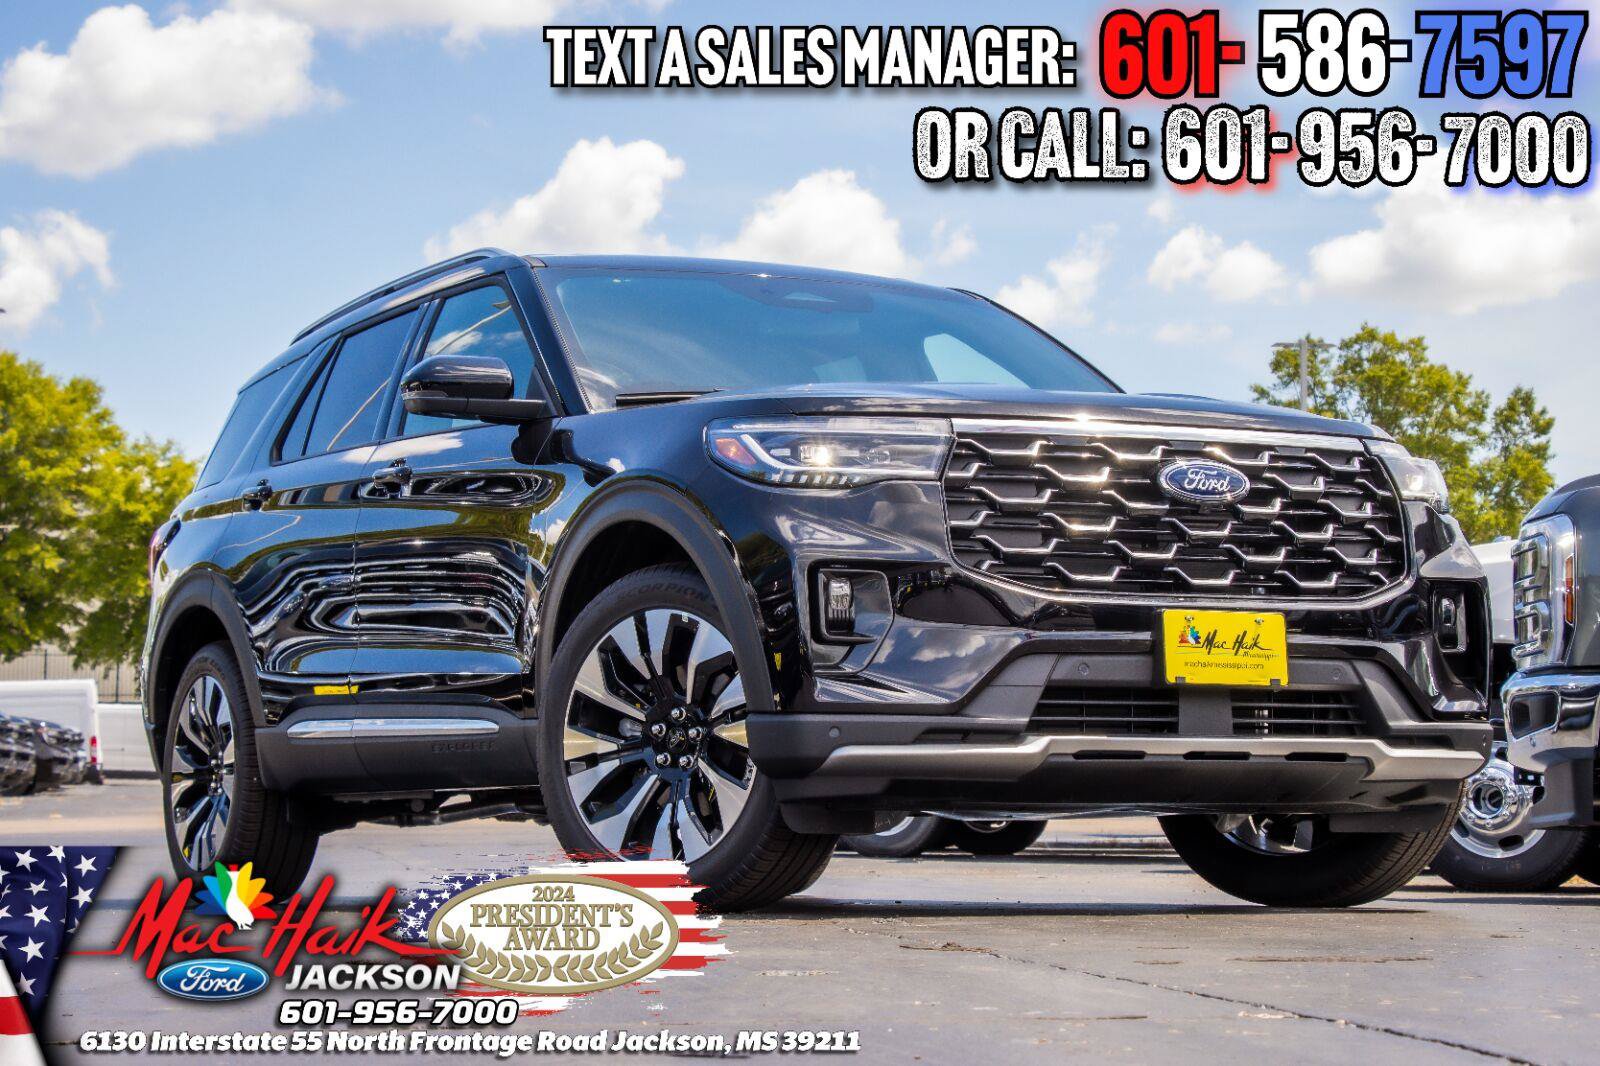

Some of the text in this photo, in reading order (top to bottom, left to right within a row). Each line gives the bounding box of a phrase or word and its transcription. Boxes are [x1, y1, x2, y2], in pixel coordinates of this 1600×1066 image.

[1184, 467, 1231, 492] Ford
[1200, 629, 1271, 656] Mac Haik
